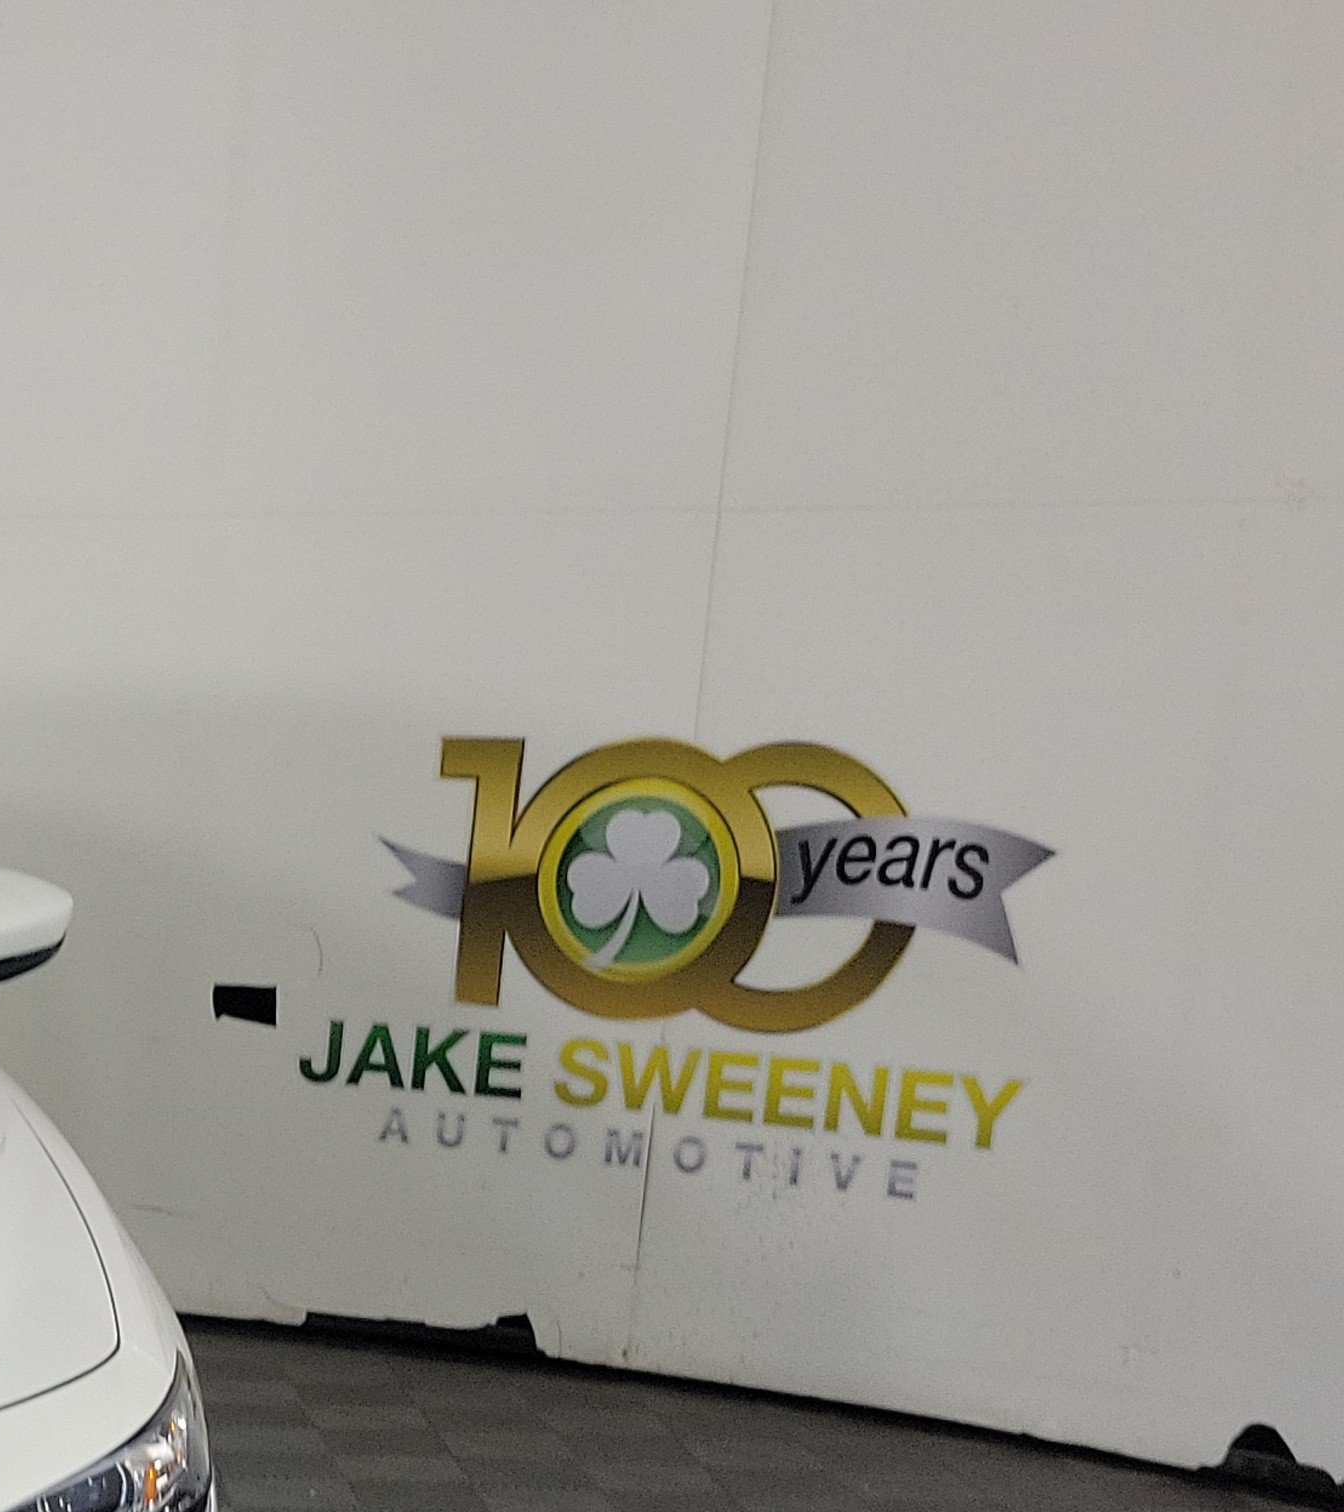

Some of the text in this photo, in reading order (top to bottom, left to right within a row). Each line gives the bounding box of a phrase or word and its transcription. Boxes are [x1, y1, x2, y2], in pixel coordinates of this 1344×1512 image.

[439, 735, 992, 1034] 100 years
[298, 1020, 1025, 1151] JAKE SWEENEY
[378, 1107, 923, 1200] AUTOMOTIVE
